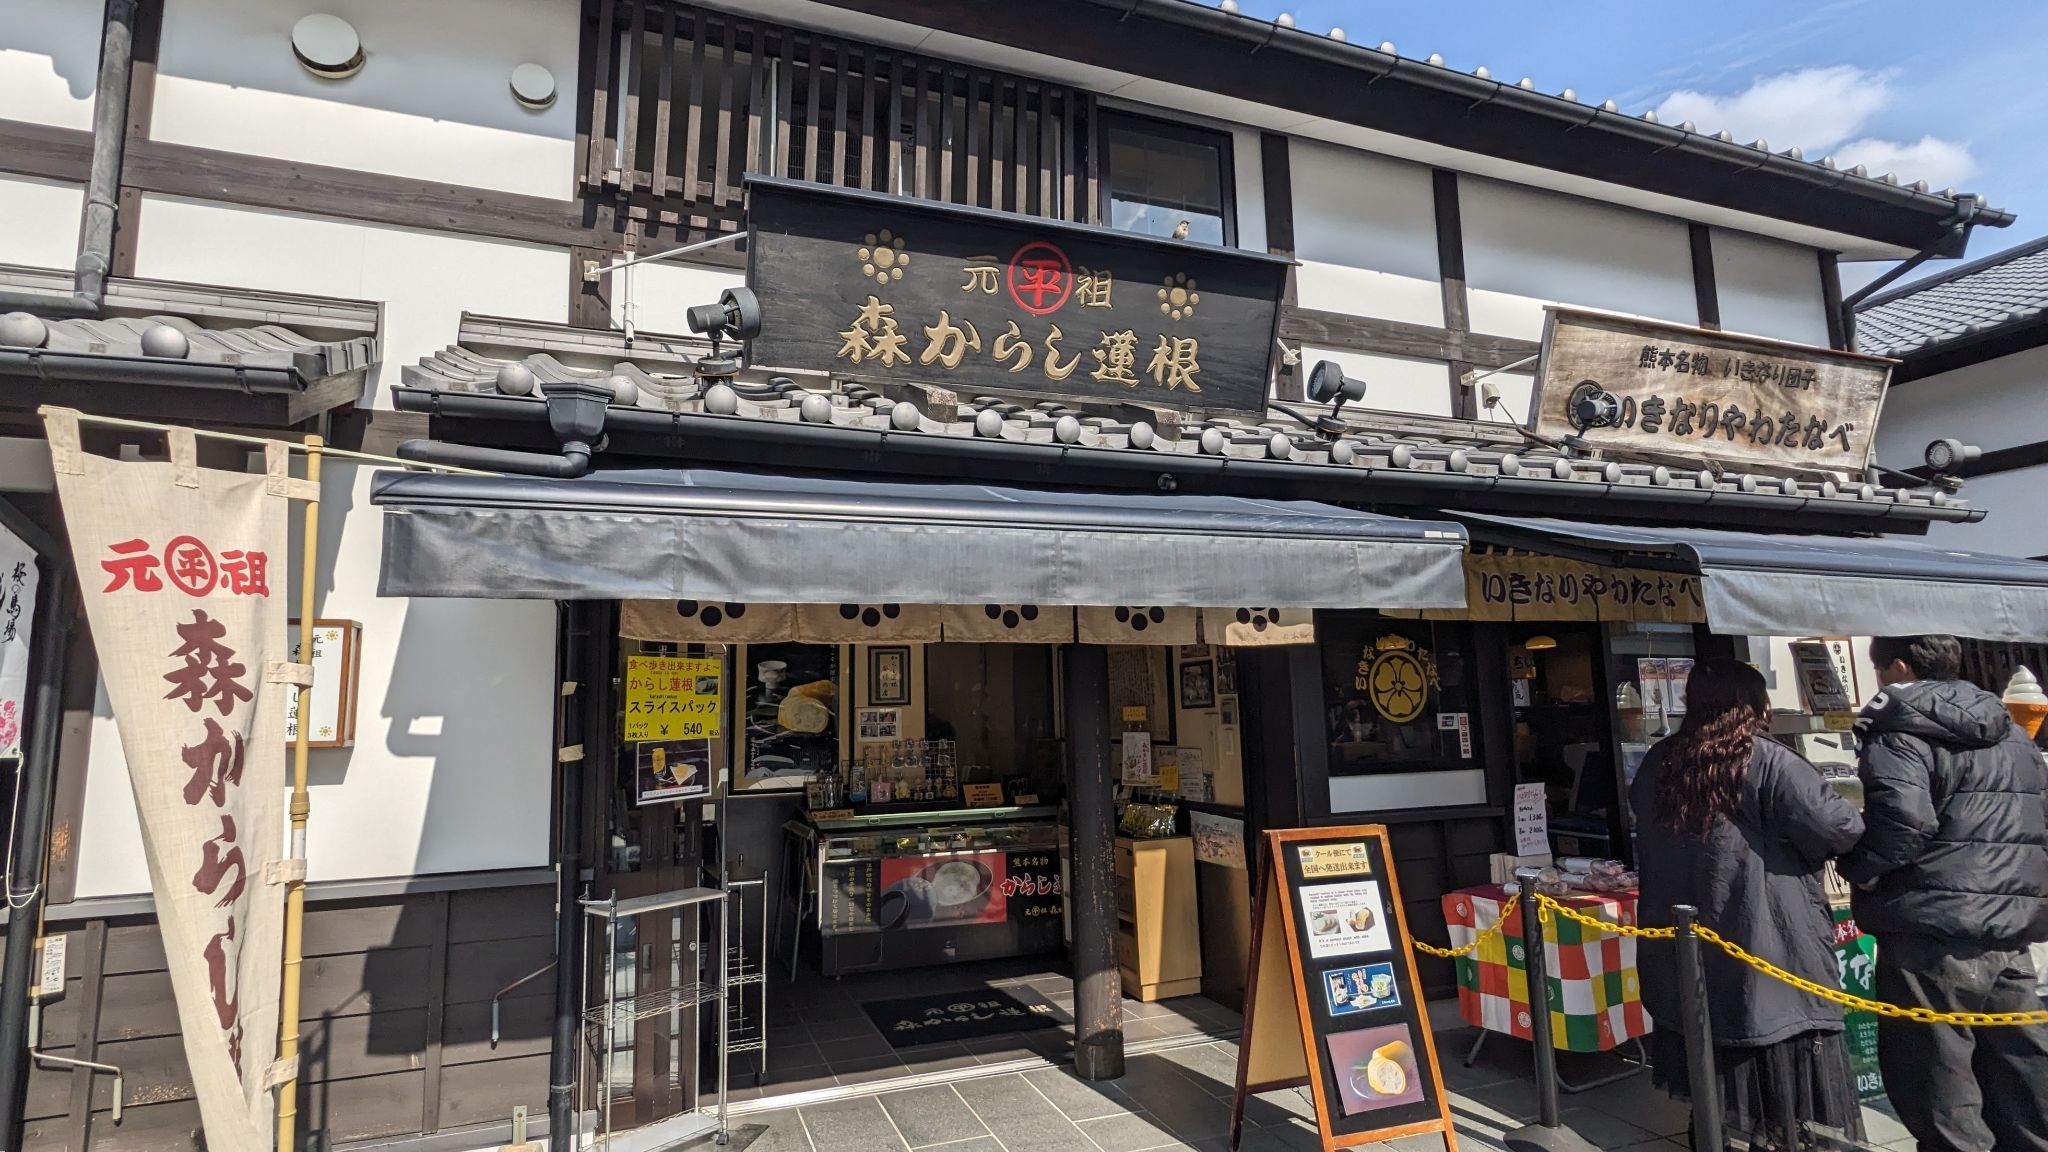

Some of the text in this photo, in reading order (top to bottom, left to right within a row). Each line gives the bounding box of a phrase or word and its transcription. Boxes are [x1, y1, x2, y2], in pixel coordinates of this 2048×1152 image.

[836, 295, 1202, 393] 森からし蓮根
[1639, 344, 1817, 391] 熊本名物 いきなり団子
[1481, 571, 1703, 608] いきなりやわたなべ
[629, 676, 693, 692] からし蓮根
[630, 700, 717, 714] スライスパック
[683, 722, 703, 735] 540
[163, 609, 254, 1086] 森からし
[1012, 856, 1049, 868] 熊本名物
[1857, 1072, 1883, 1092] いき
